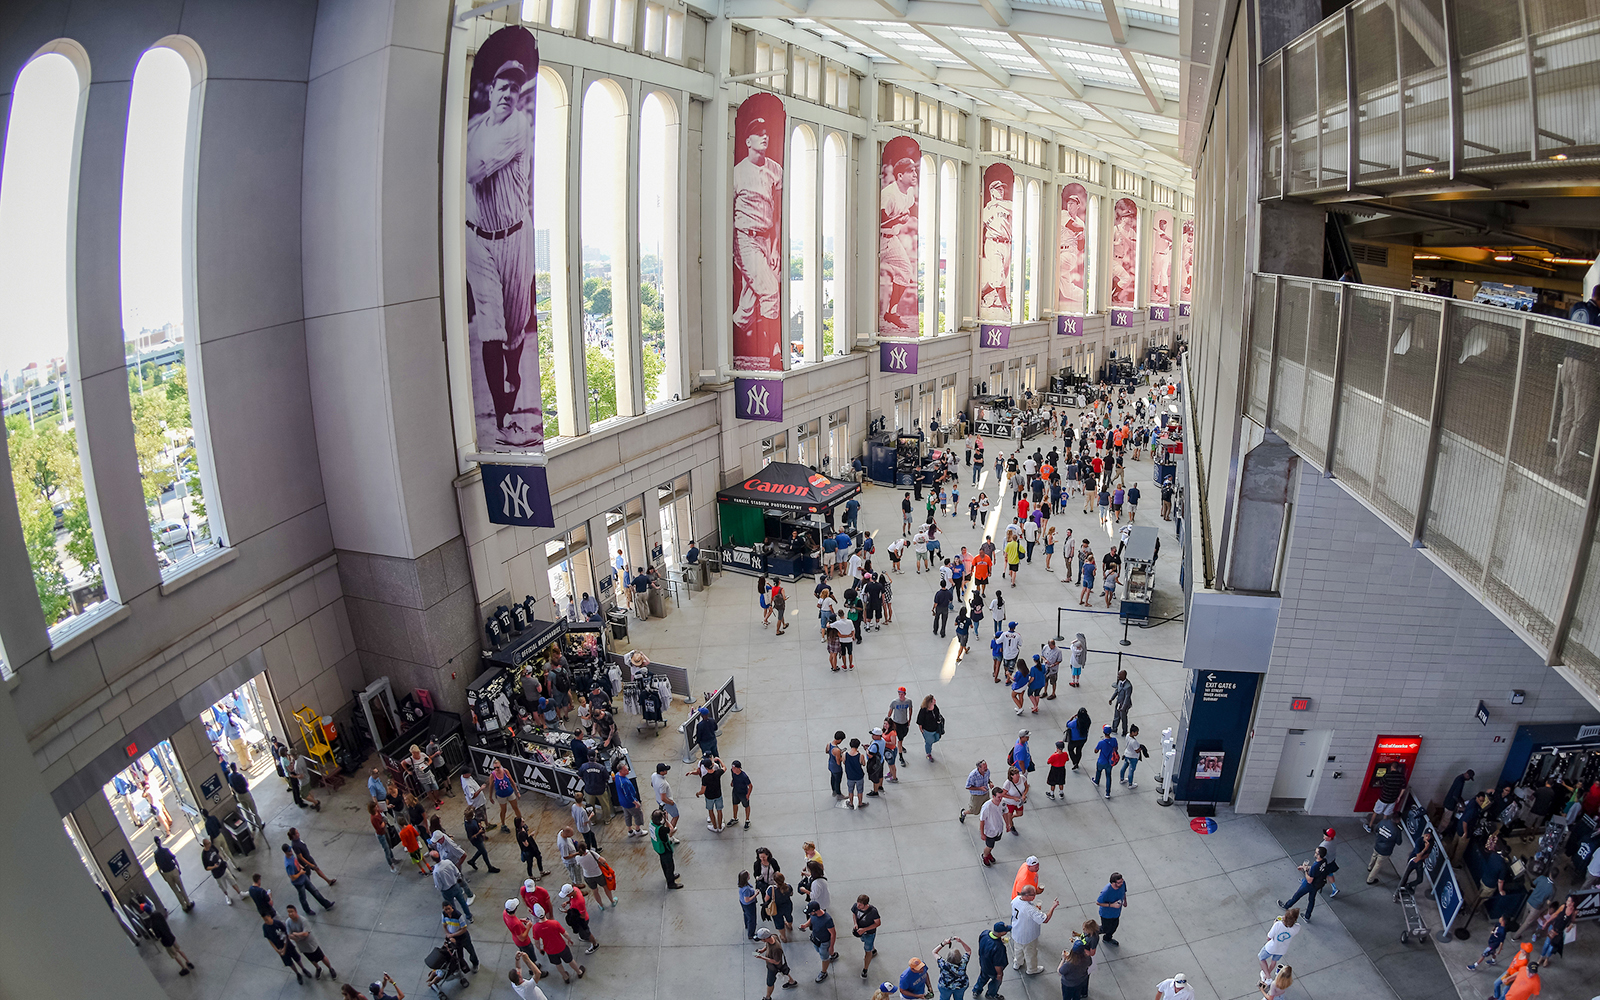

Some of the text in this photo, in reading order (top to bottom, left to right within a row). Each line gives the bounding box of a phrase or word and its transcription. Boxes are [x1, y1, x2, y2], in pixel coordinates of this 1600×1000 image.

[1116, 312, 1127, 325] NY
[1063, 318, 1076, 334] NY
[986, 328, 1002, 346] NY
[889, 346, 908, 370] NY
[746, 384, 770, 416] NY
[743, 479, 810, 497] Canon
[821, 483, 845, 496] Canon
[499, 473, 535, 520] NY
[770, 502, 802, 511] PHOTOGRAPHY
[521, 625, 561, 658] OFFICIAL MERCHANDISE
[1218, 682, 1232, 690] GATE
[1293, 699, 1308, 710] EXIT
[1478, 710, 1487, 724] ATM
[523, 777, 551, 790] Majestic
[1014, 908, 1019, 919] 7
